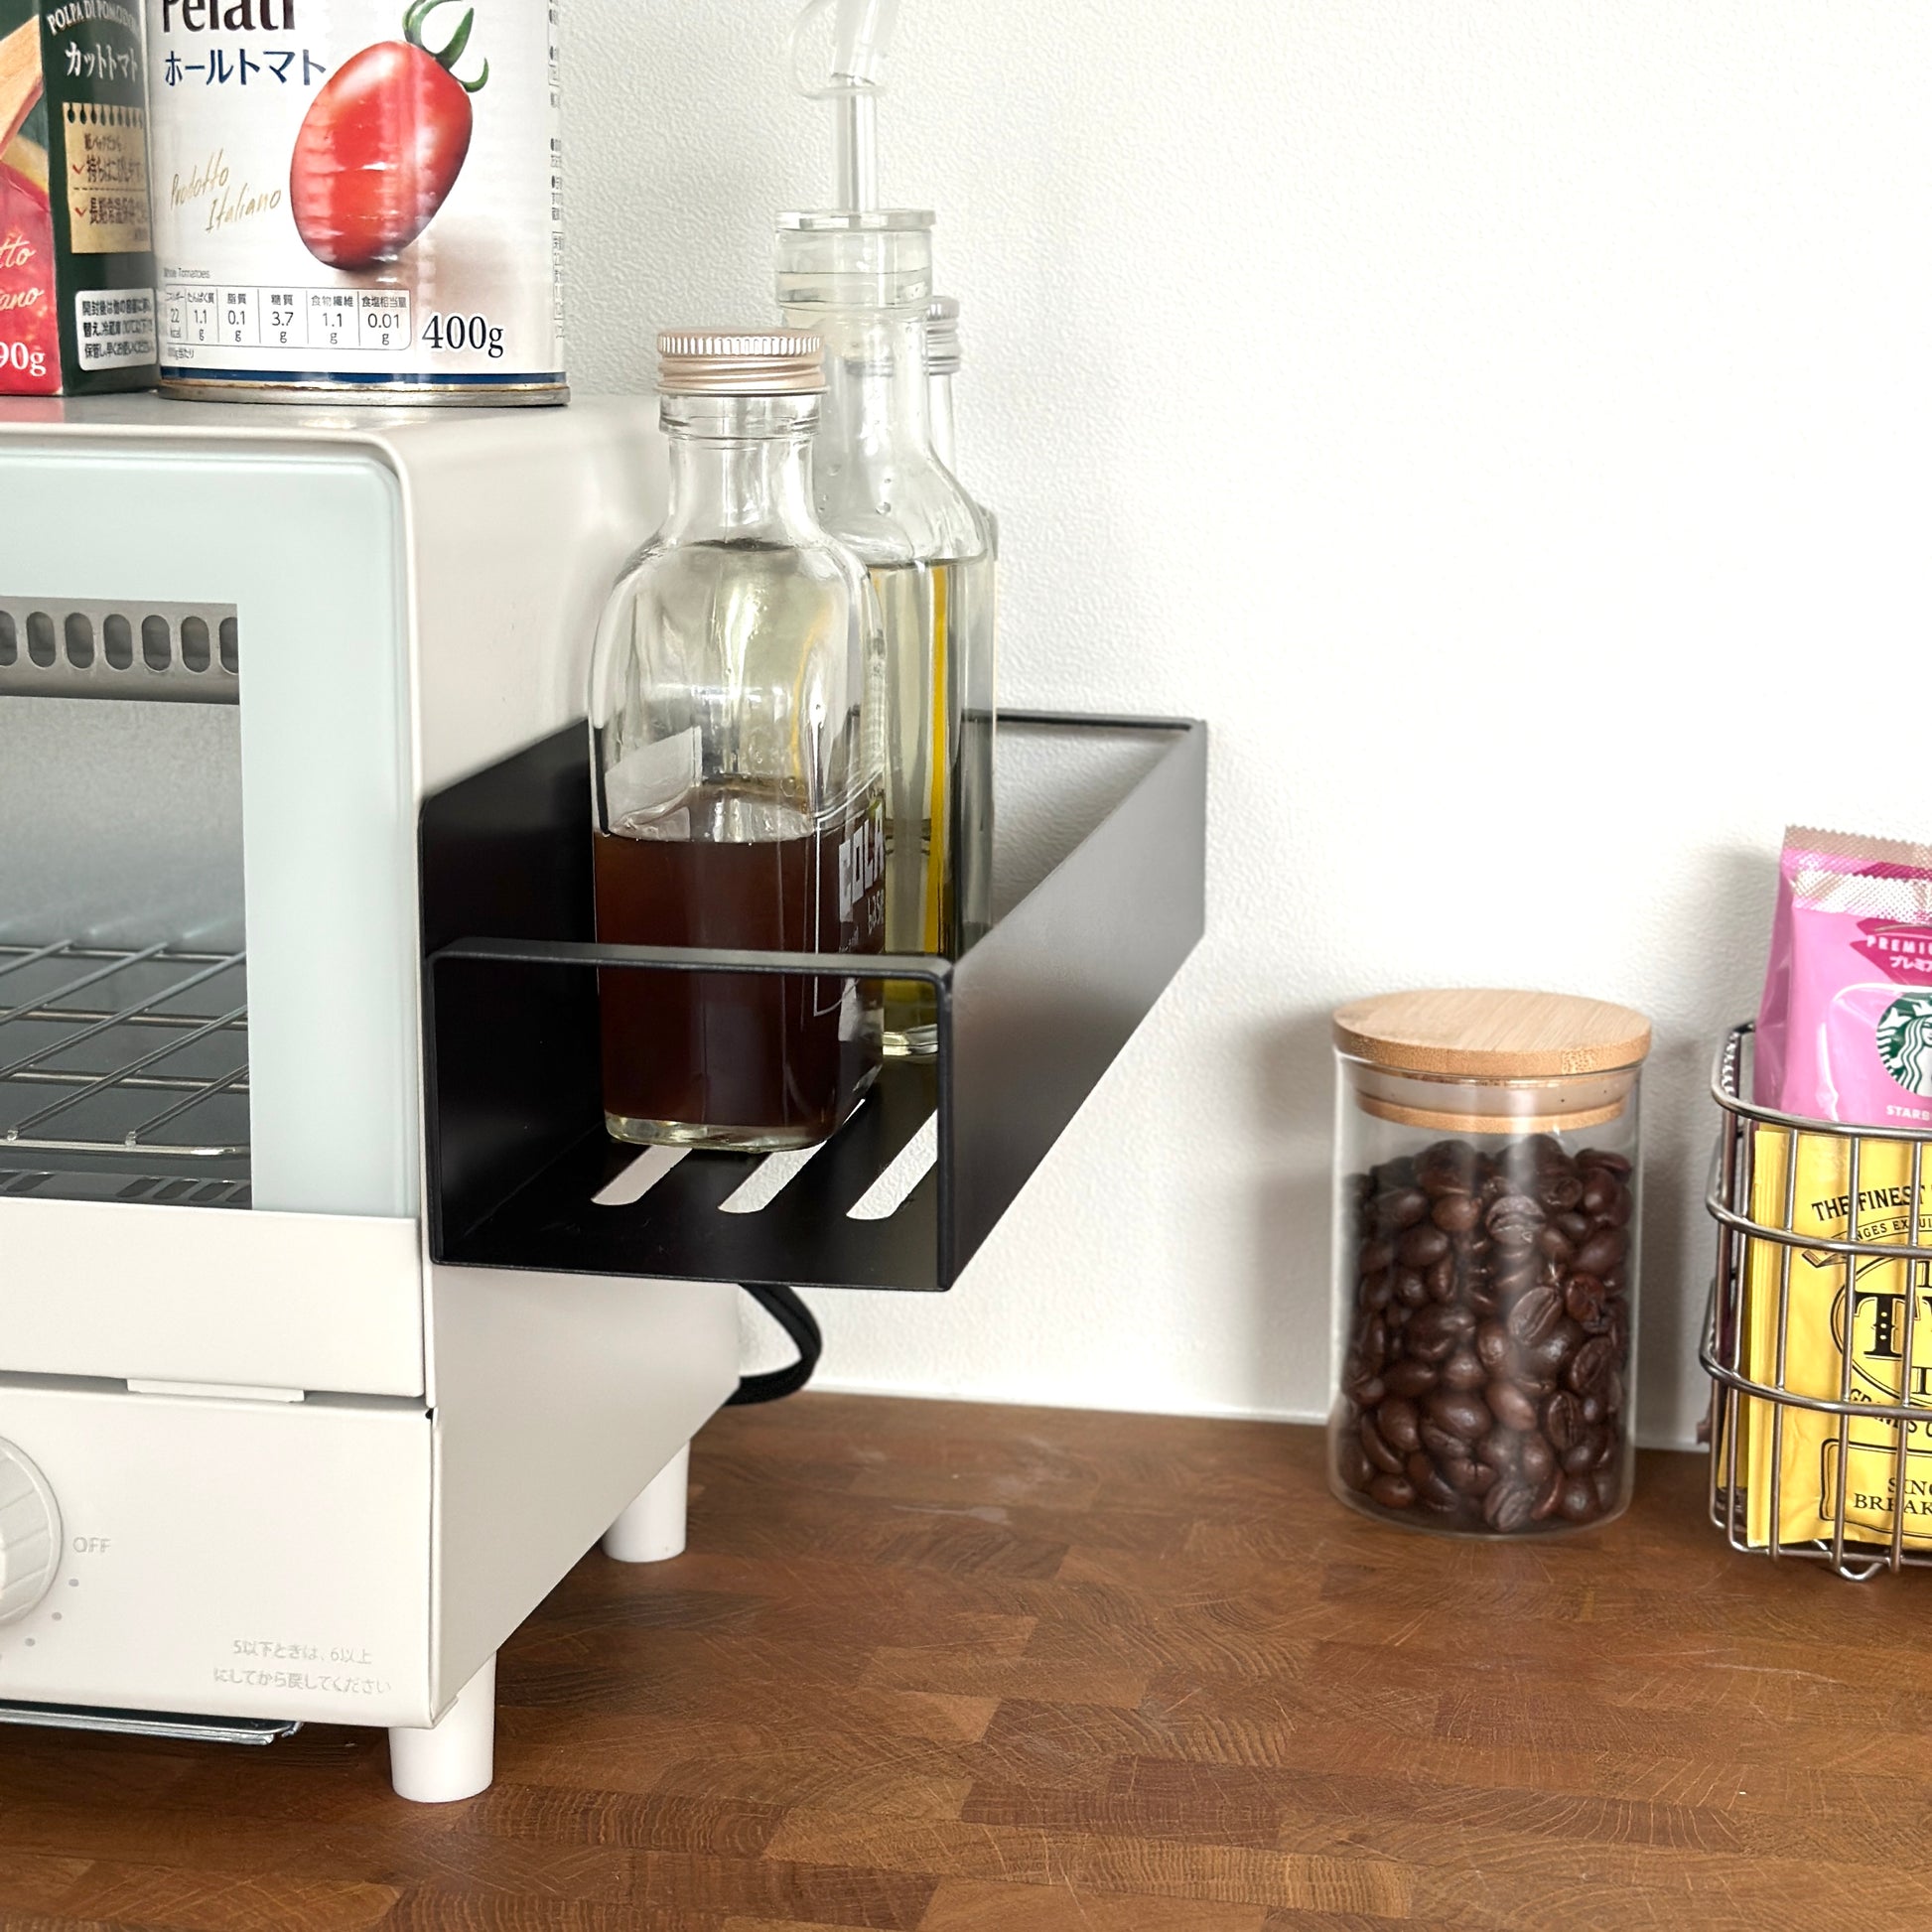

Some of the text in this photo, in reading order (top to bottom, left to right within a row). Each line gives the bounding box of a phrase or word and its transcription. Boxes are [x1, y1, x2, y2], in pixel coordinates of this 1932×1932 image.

[47, 2, 84, 36] POLPA
[65, 41, 138, 83] カットトマト
[165, 49, 327, 86] ホールトマト
[206, 183, 282, 232] Italiano
[194, 309, 207, 325] 1.1
[227, 310, 245, 326] 0.1
[271, 311, 294, 327] 3.7
[322, 313, 343, 328] 1.1
[367, 313, 400, 329] 0.01
[199, 329, 205, 342] g
[234, 330, 242, 343] g
[279, 331, 288, 344] g
[330, 332, 339, 345] g
[381, 333, 390, 345] g
[421, 315, 504, 358] 400g
[1886, 1104, 1930, 1122] STARB
[1811, 1194, 1850, 1222] THE
[1892, 1217, 1932, 1232] EXUI
[72, 1536, 112, 1554] OFF
[212, 1657, 392, 1695] にしてから戻してください
